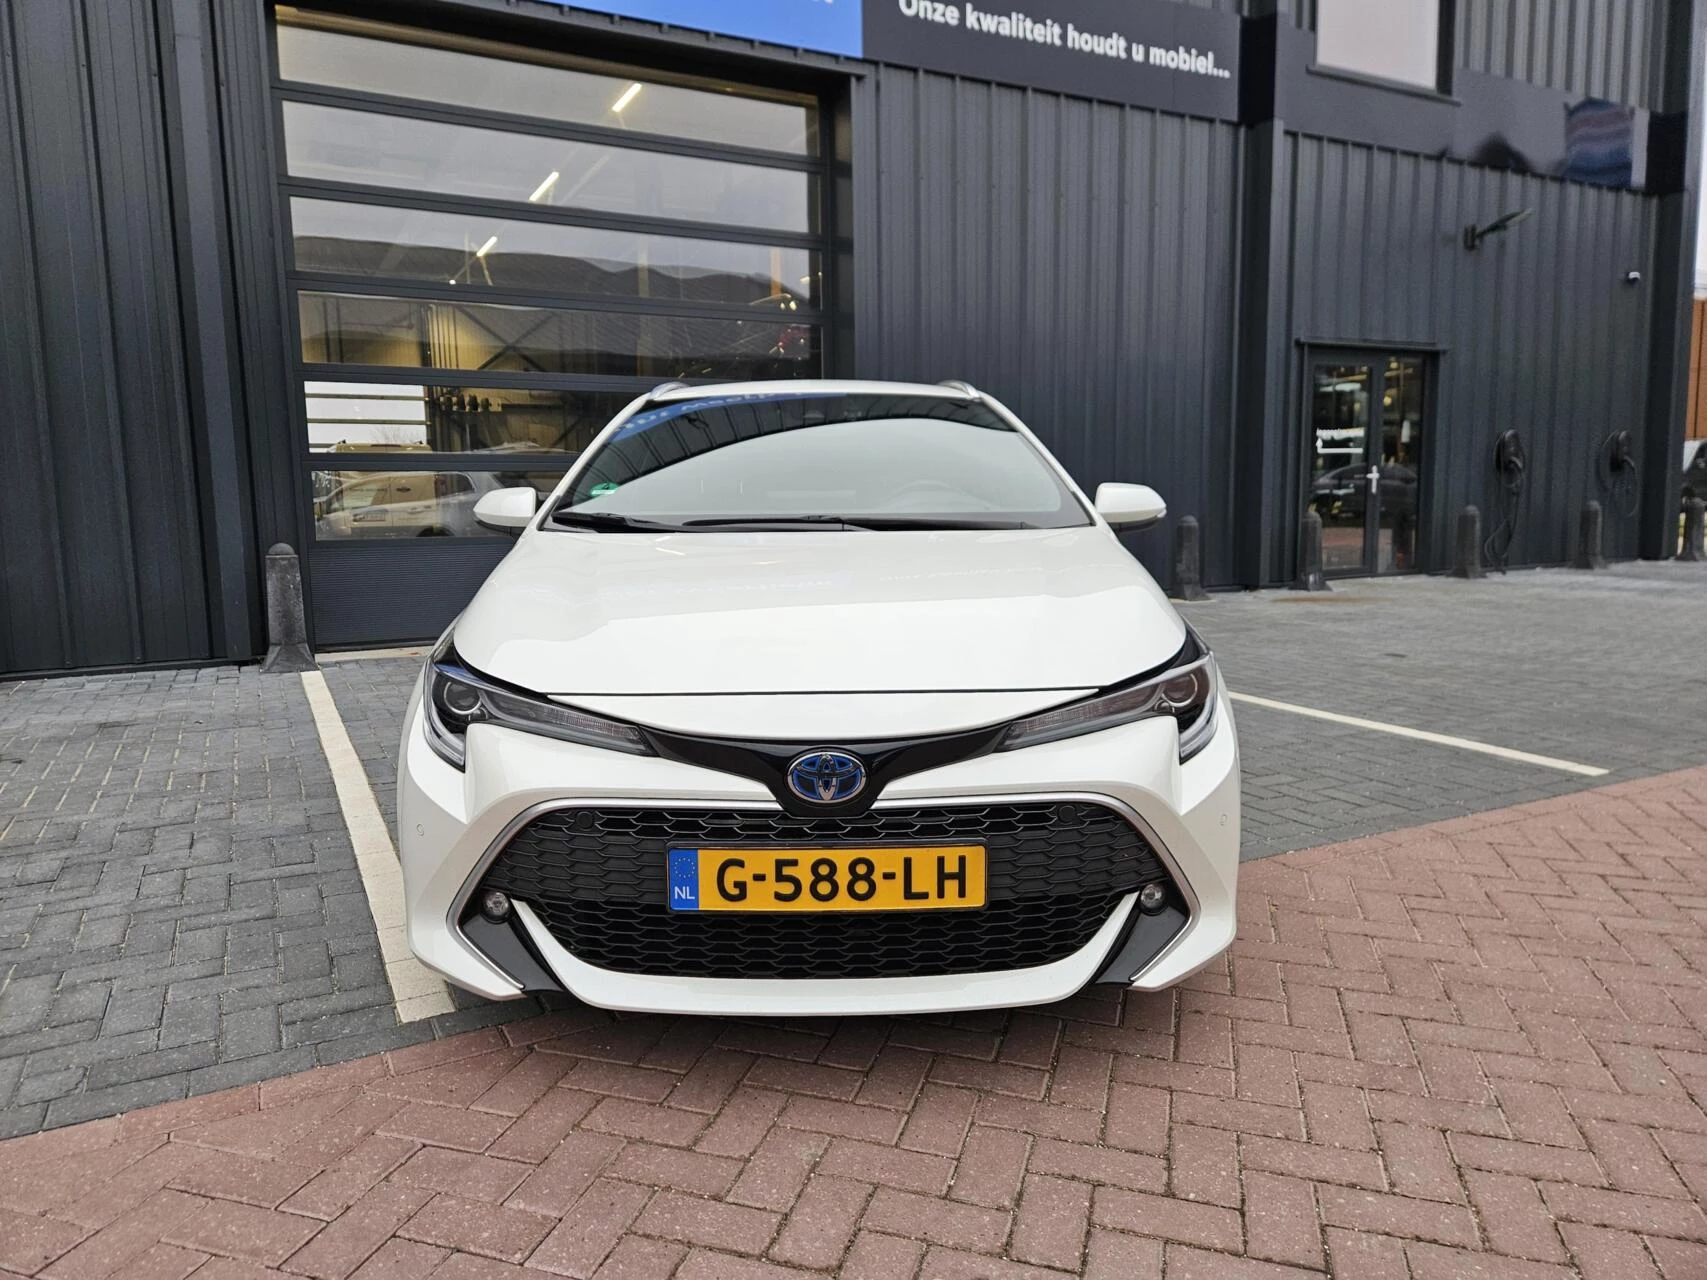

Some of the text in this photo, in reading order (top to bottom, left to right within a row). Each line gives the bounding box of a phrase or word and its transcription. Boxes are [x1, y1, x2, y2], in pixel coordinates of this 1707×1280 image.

[899, 0, 1231, 79] Onze kwaliteit houdt u mobiel...
[674, 886, 695, 900] NL
[716, 855, 967, 903] G-588-LH
